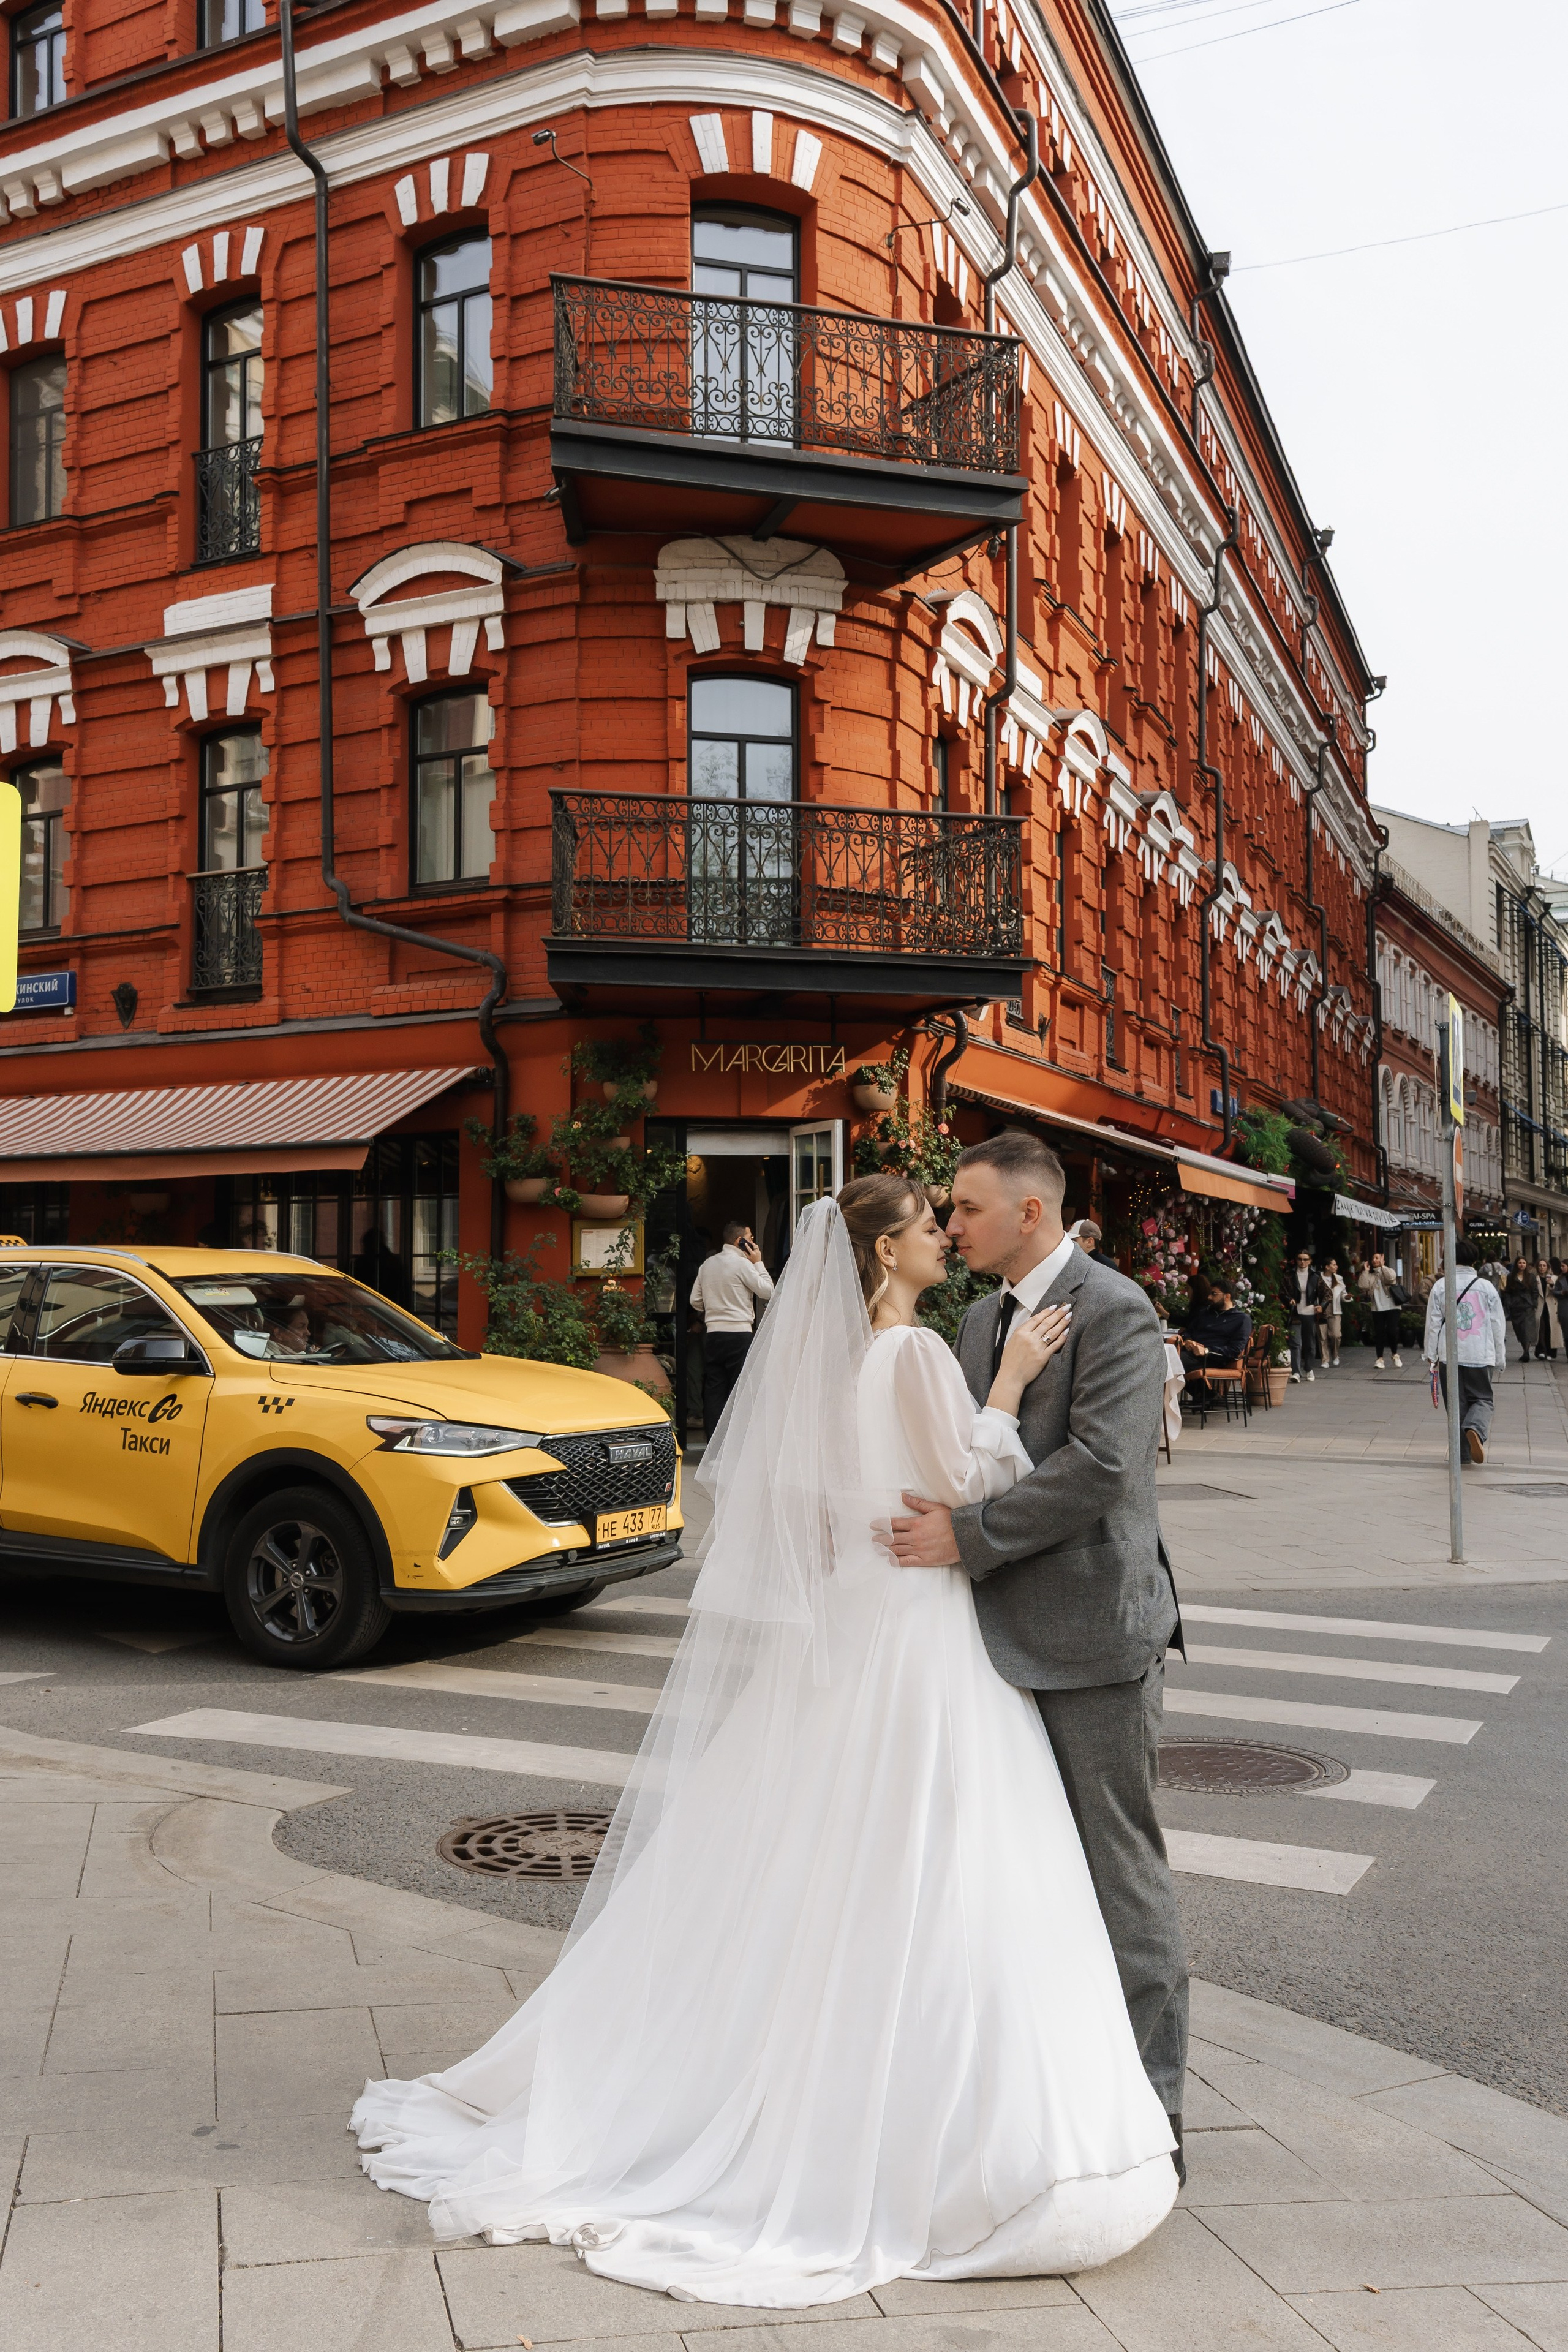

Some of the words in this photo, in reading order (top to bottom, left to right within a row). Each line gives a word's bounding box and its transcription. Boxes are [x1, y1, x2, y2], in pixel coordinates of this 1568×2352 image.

[691, 1043, 846, 1074] MARGARITA
[79, 1391, 151, 1419] Яндекс
[147, 1393, 183, 1423] Go
[120, 1427, 171, 1455] Такси
[614, 1447, 651, 1460] HAVAL
[622, 1511, 644, 1534] 433
[650, 1507, 662, 1523] 77
